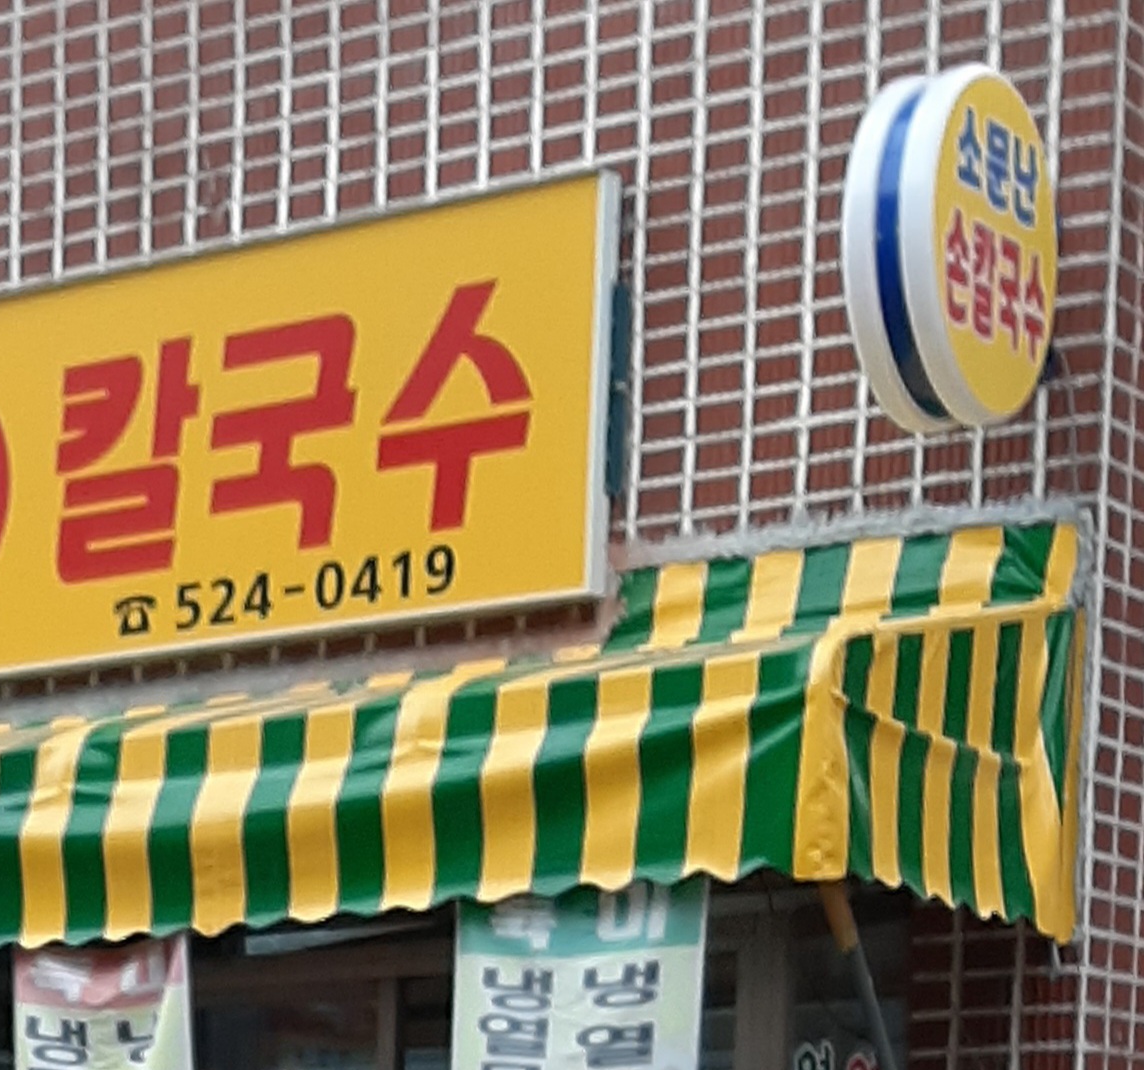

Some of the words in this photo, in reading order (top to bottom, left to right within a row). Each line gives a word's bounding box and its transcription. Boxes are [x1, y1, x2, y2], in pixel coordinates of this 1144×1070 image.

[957, 105, 1039, 230] 소문난
[944, 207, 1046, 365] 손칼국수
[56, 278, 535, 585] 칼국수
[174, 545, 457, 630] 524-0419
